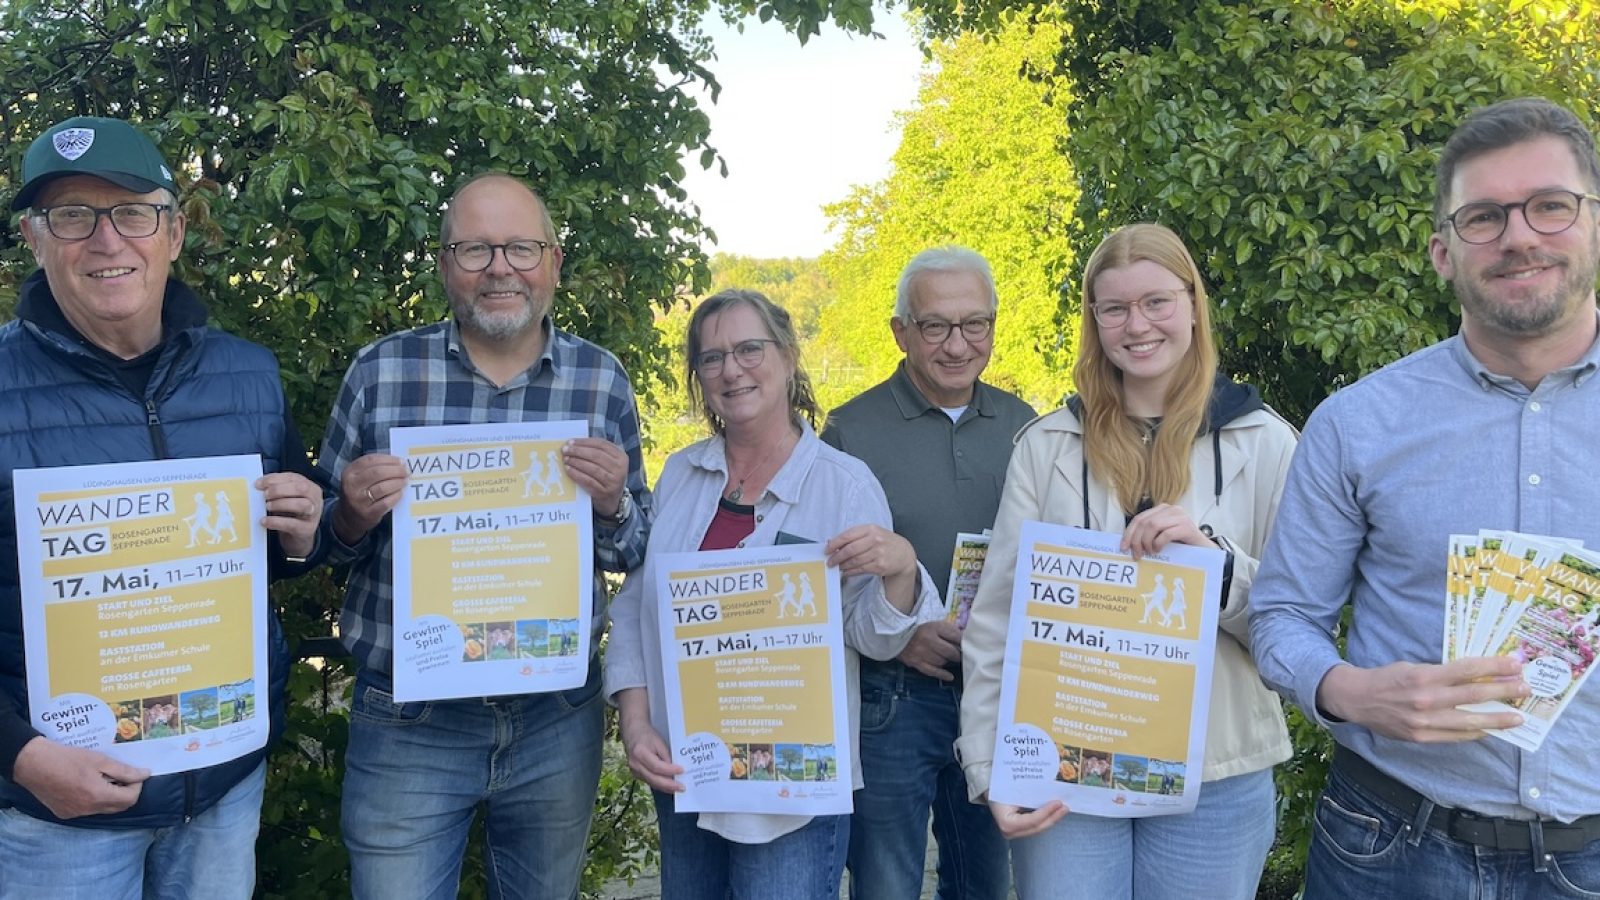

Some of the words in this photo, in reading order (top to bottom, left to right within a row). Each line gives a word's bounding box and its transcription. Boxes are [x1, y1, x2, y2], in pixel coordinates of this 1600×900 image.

[408, 450, 510, 474] WANDER
[411, 481, 460, 500] TAG
[37, 492, 170, 526] WANDER
[418, 518, 447, 534] 17.
[455, 512, 500, 531] Mai,
[550, 510, 570, 521] Uhr
[112, 524, 180, 540] ROSENGARTEN
[42, 532, 106, 557] TAG
[113, 536, 170, 550] SEPPENRADE
[1031, 554, 1134, 584] WANDER
[52, 578, 90, 598] 17.
[102, 568, 158, 592] Mai,
[219, 559, 244, 574] Uhr
[669, 572, 764, 598] WANDER
[1030, 582, 1075, 605] TAG
[1080, 590, 1136, 604] ROSENGARTEN
[1544, 582, 1578, 608] TAG
[98, 601, 128, 611] START
[130, 598, 152, 608] UND
[98, 608, 160, 620] Rosengarten
[162, 598, 216, 614] Seppenrade
[1080, 600, 1128, 612] SEPPENRADE
[674, 604, 718, 624] TAG
[130, 615, 220, 635] RUNDWANDERWEG
[403, 624, 450, 640] Gewinn-
[100, 642, 165, 656] RASTSTATION
[181, 644, 210, 655] Schule
[416, 634, 442, 650] Spiel
[682, 640, 709, 656] 17.
[718, 634, 758, 652] Mai,
[802, 632, 822, 644] Uhr
[1031, 621, 1058, 640] 17.
[1066, 626, 1110, 652] Mai,
[1164, 646, 1190, 660] Uhr
[142, 664, 192, 678] CAFETERIA
[116, 677, 178, 690] Rosengarten
[42, 704, 98, 722] Gewinn-
[56, 714, 90, 732] Spiel
[1004, 734, 1048, 744] Gewinn-
[680, 742, 720, 756] Gewinn-
[690, 750, 714, 764] Spiel
[1014, 746, 1039, 758] Spiel
